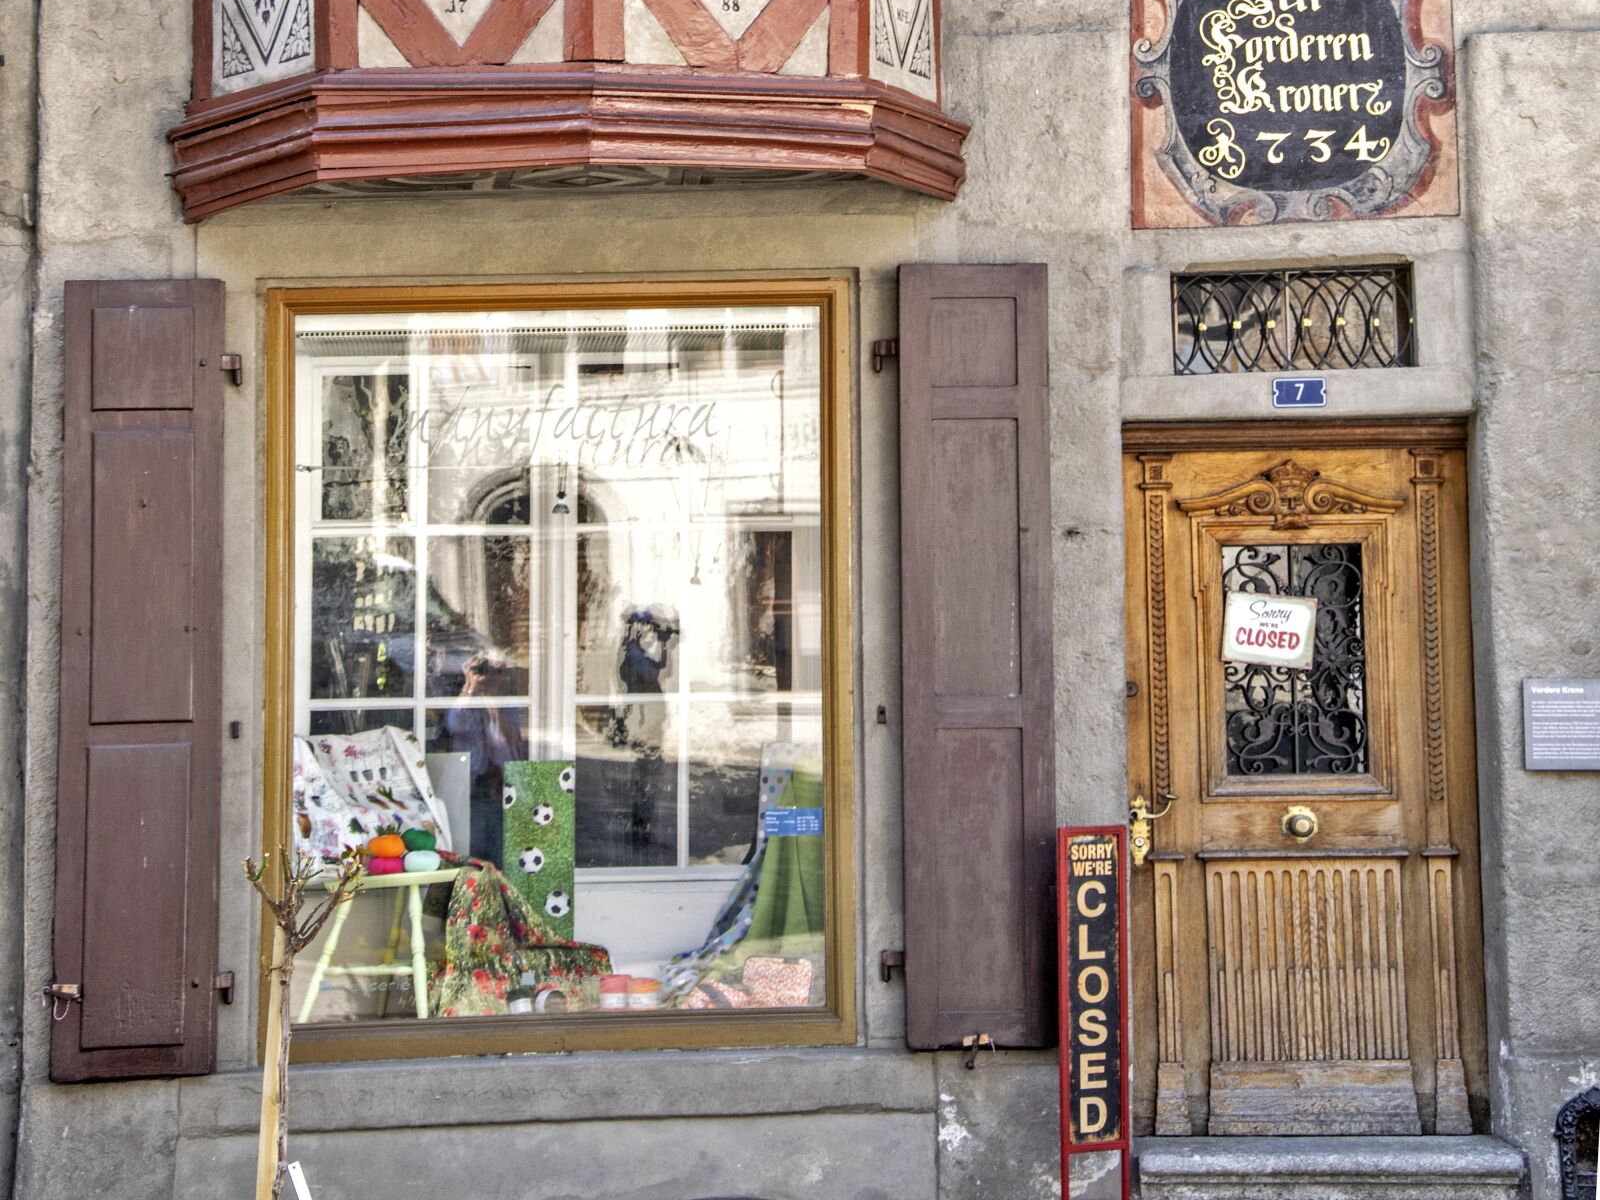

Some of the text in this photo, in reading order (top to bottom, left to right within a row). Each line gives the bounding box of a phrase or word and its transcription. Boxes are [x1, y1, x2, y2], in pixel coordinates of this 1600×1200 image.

[721, 0, 741, 12] 88
[1294, 383, 1305, 401] 7
[391, 383, 720, 457] manufactura
[1249, 600, 1293, 624] Sorry
[1235, 626, 1301, 650] CLOSED
[1070, 843, 1113, 861] SORRY
[1072, 860, 1112, 877] WE'RE
[1075, 880, 1110, 1135] CLOSED
